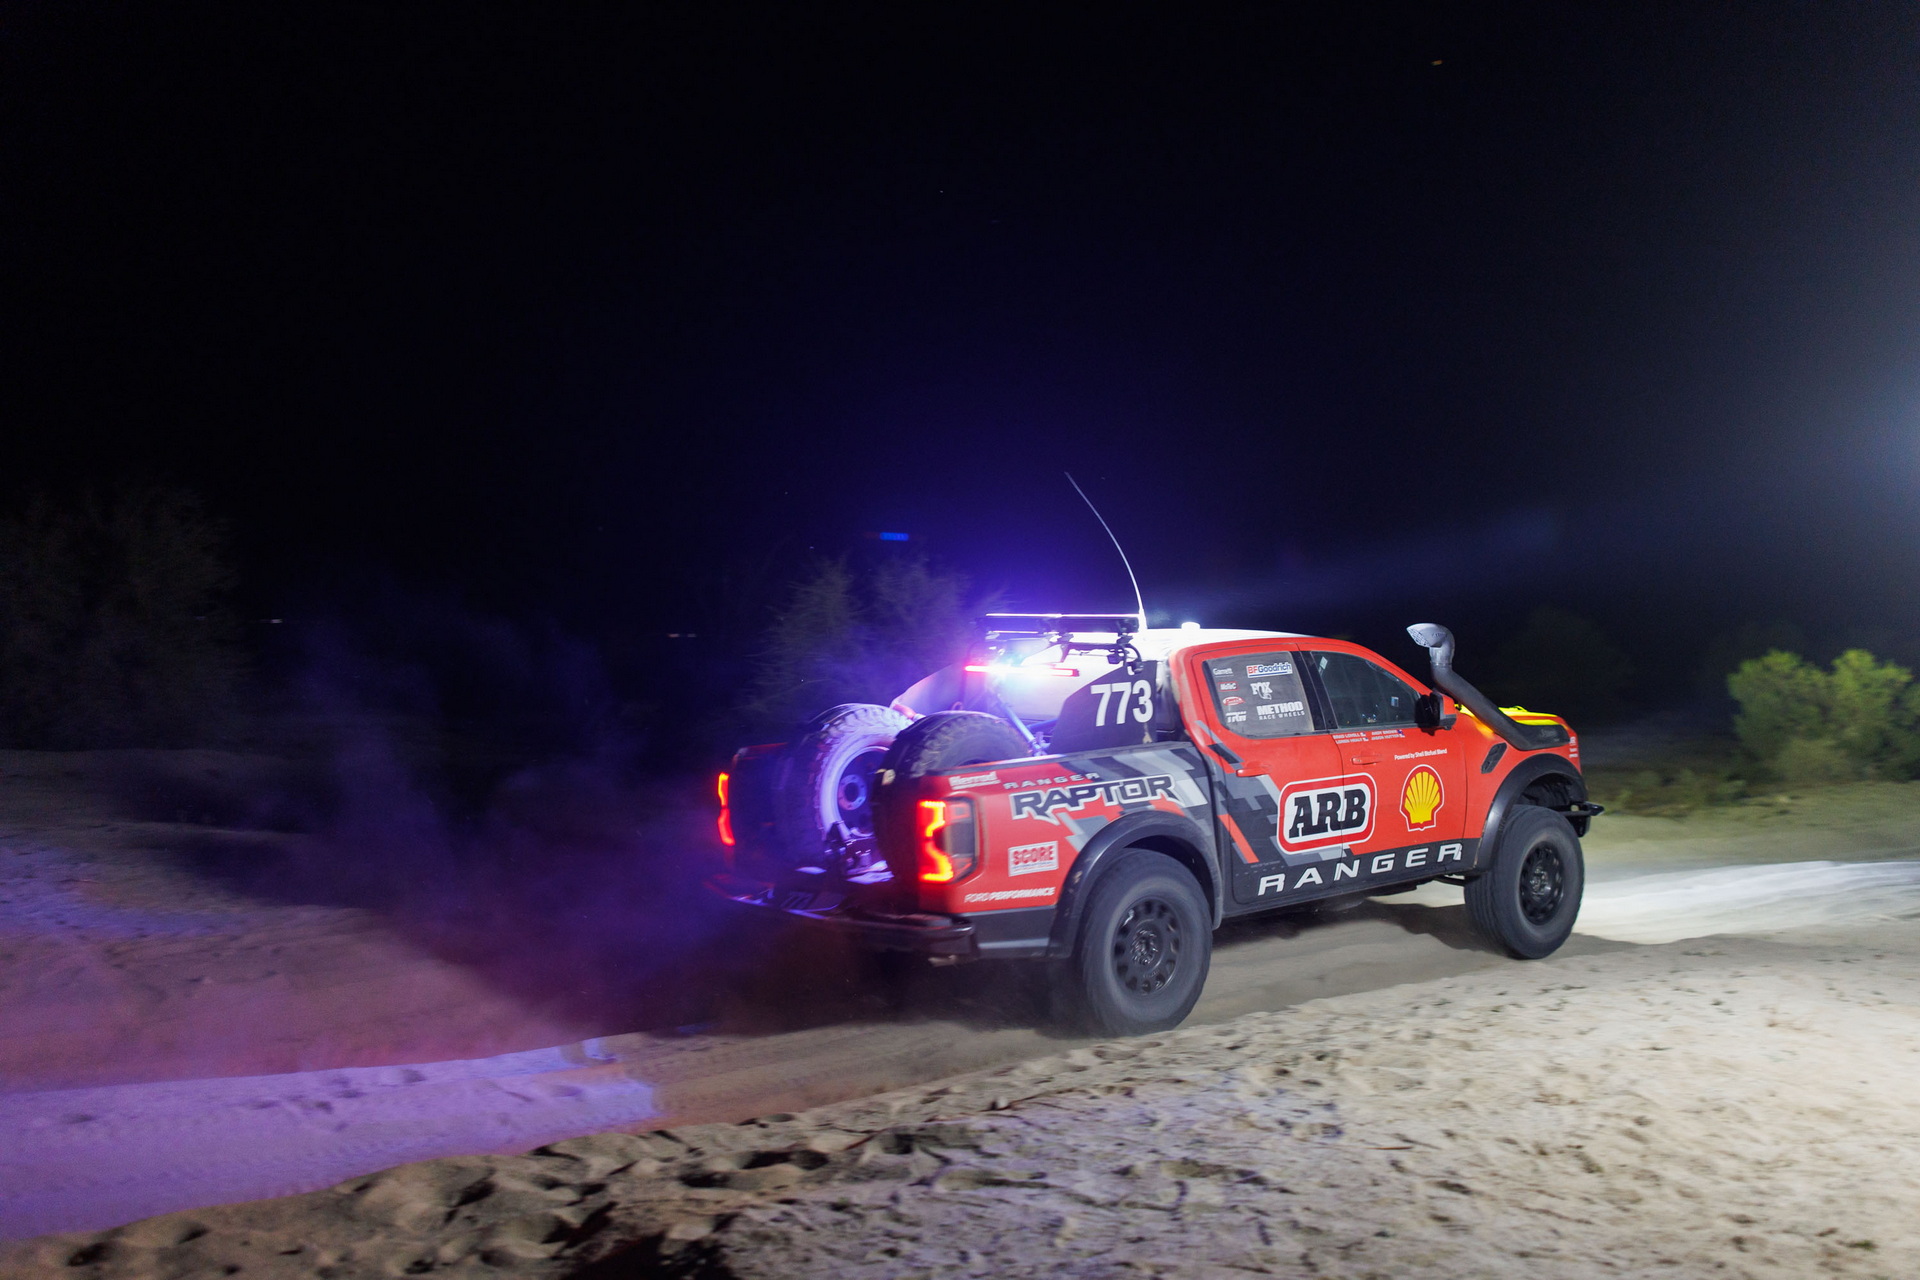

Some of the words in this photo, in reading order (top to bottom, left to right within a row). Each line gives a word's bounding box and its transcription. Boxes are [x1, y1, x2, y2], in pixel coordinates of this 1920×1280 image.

[1247, 662, 1292, 674] BFGoodrich
[1250, 682, 1273, 700] FOX
[1090, 679, 1154, 727] 773
[1256, 701, 1304, 716] METHOD
[1259, 713, 1276, 721] RACE
[1278, 710, 1305, 719] WHEELS
[1003, 772, 1100, 790] RANGER
[1009, 774, 1186, 826] RAPTOR
[1288, 788, 1367, 839] ARB
[1013, 845, 1055, 865] SCORE
[1257, 843, 1463, 896] RANGER
[964, 892, 989, 903] FORD
[989, 887, 1056, 901] PERFORMANCE
